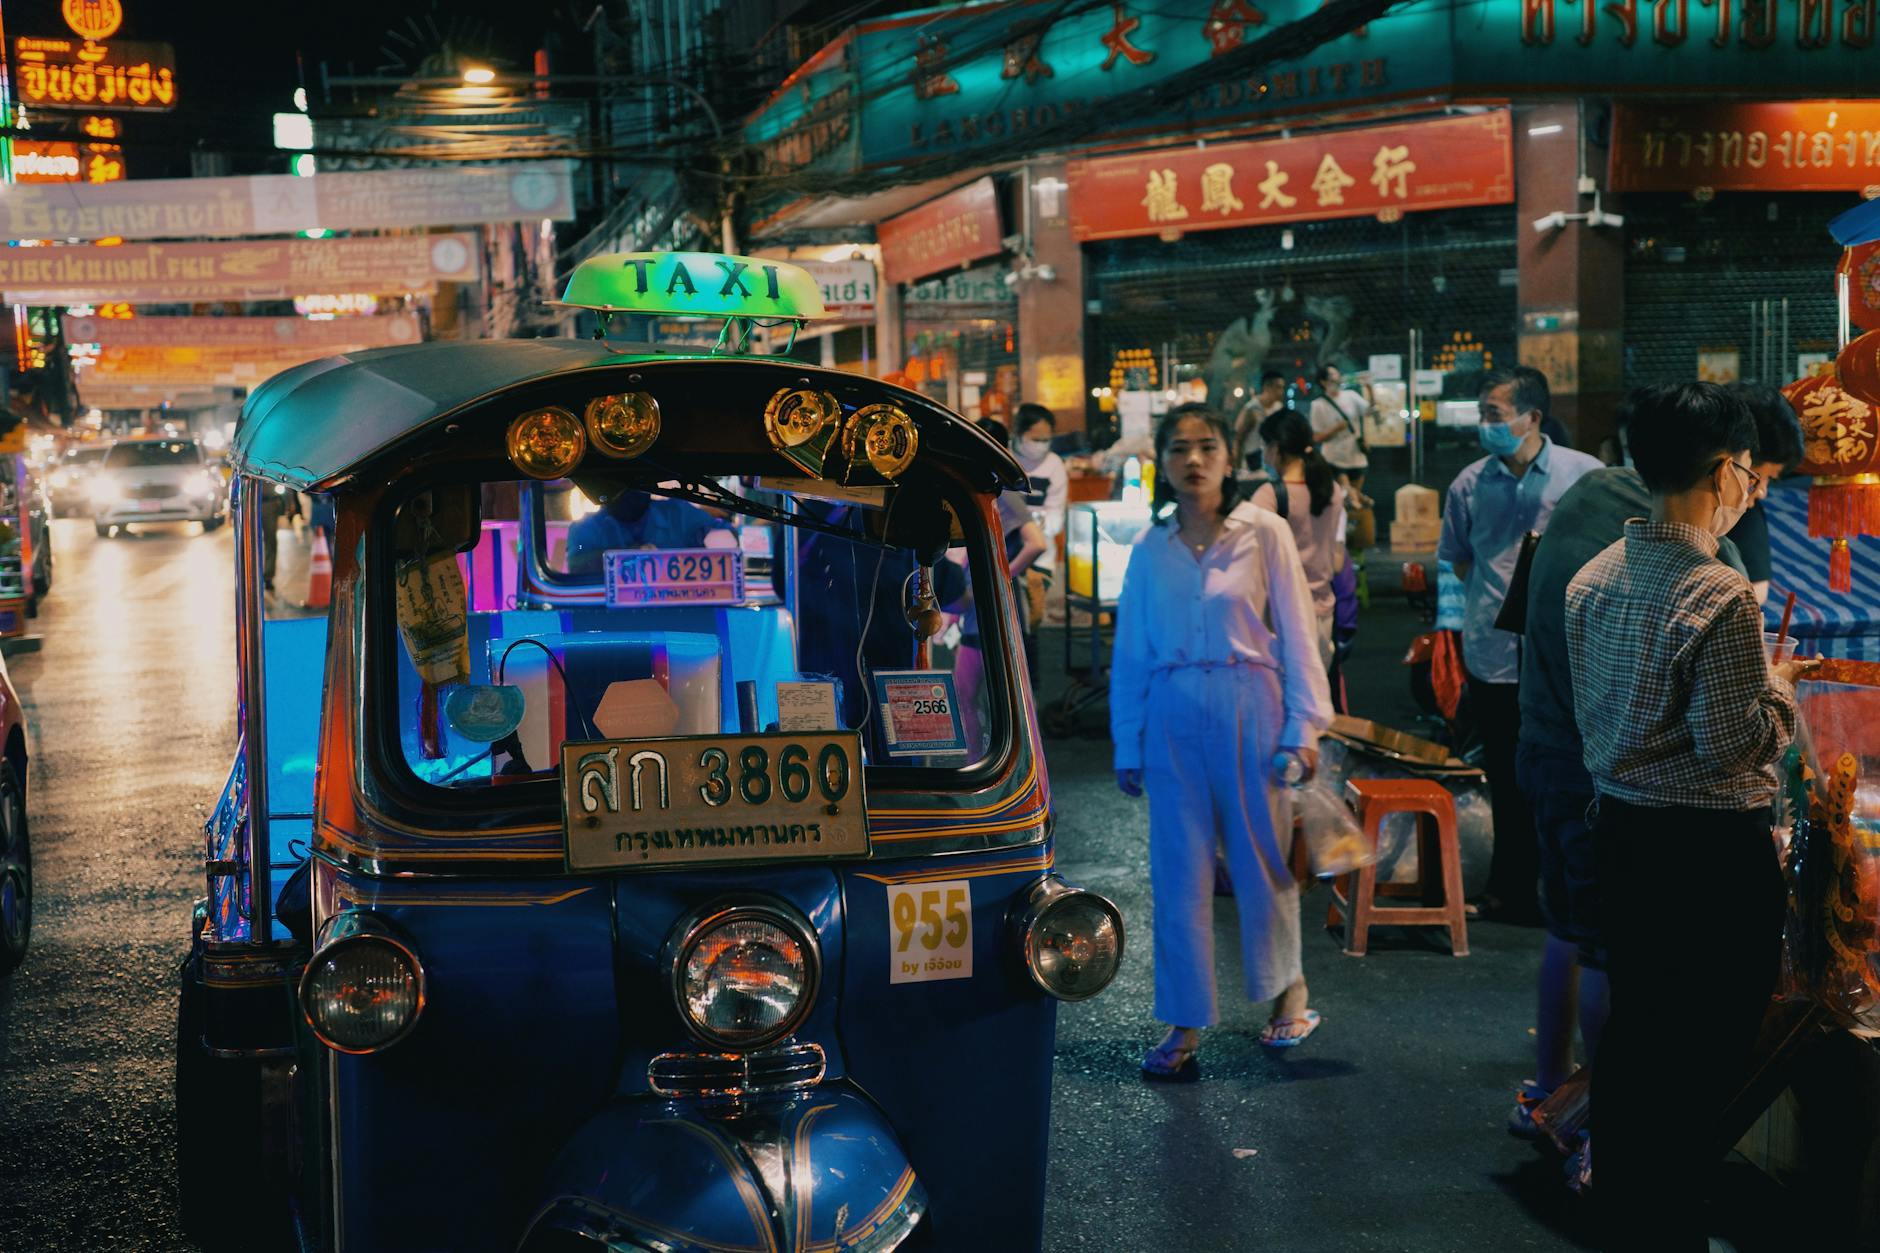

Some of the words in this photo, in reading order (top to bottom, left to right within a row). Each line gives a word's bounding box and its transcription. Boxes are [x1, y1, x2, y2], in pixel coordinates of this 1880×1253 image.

[910, 96, 1107, 149] LANGHO
[1168, 58, 1387, 112] LDSMITH
[1141, 145, 1417, 221] 龍鳳大金行
[624, 259, 780, 300] TAXI
[667, 556, 727, 581] 6291
[913, 699, 948, 715] 2566
[577, 747, 670, 812] สก
[699, 743, 850, 807] 3860
[614, 822, 821, 860] กรุงเทพมหานคร
[893, 888, 969, 953] 955
[902, 960, 919, 976] by
